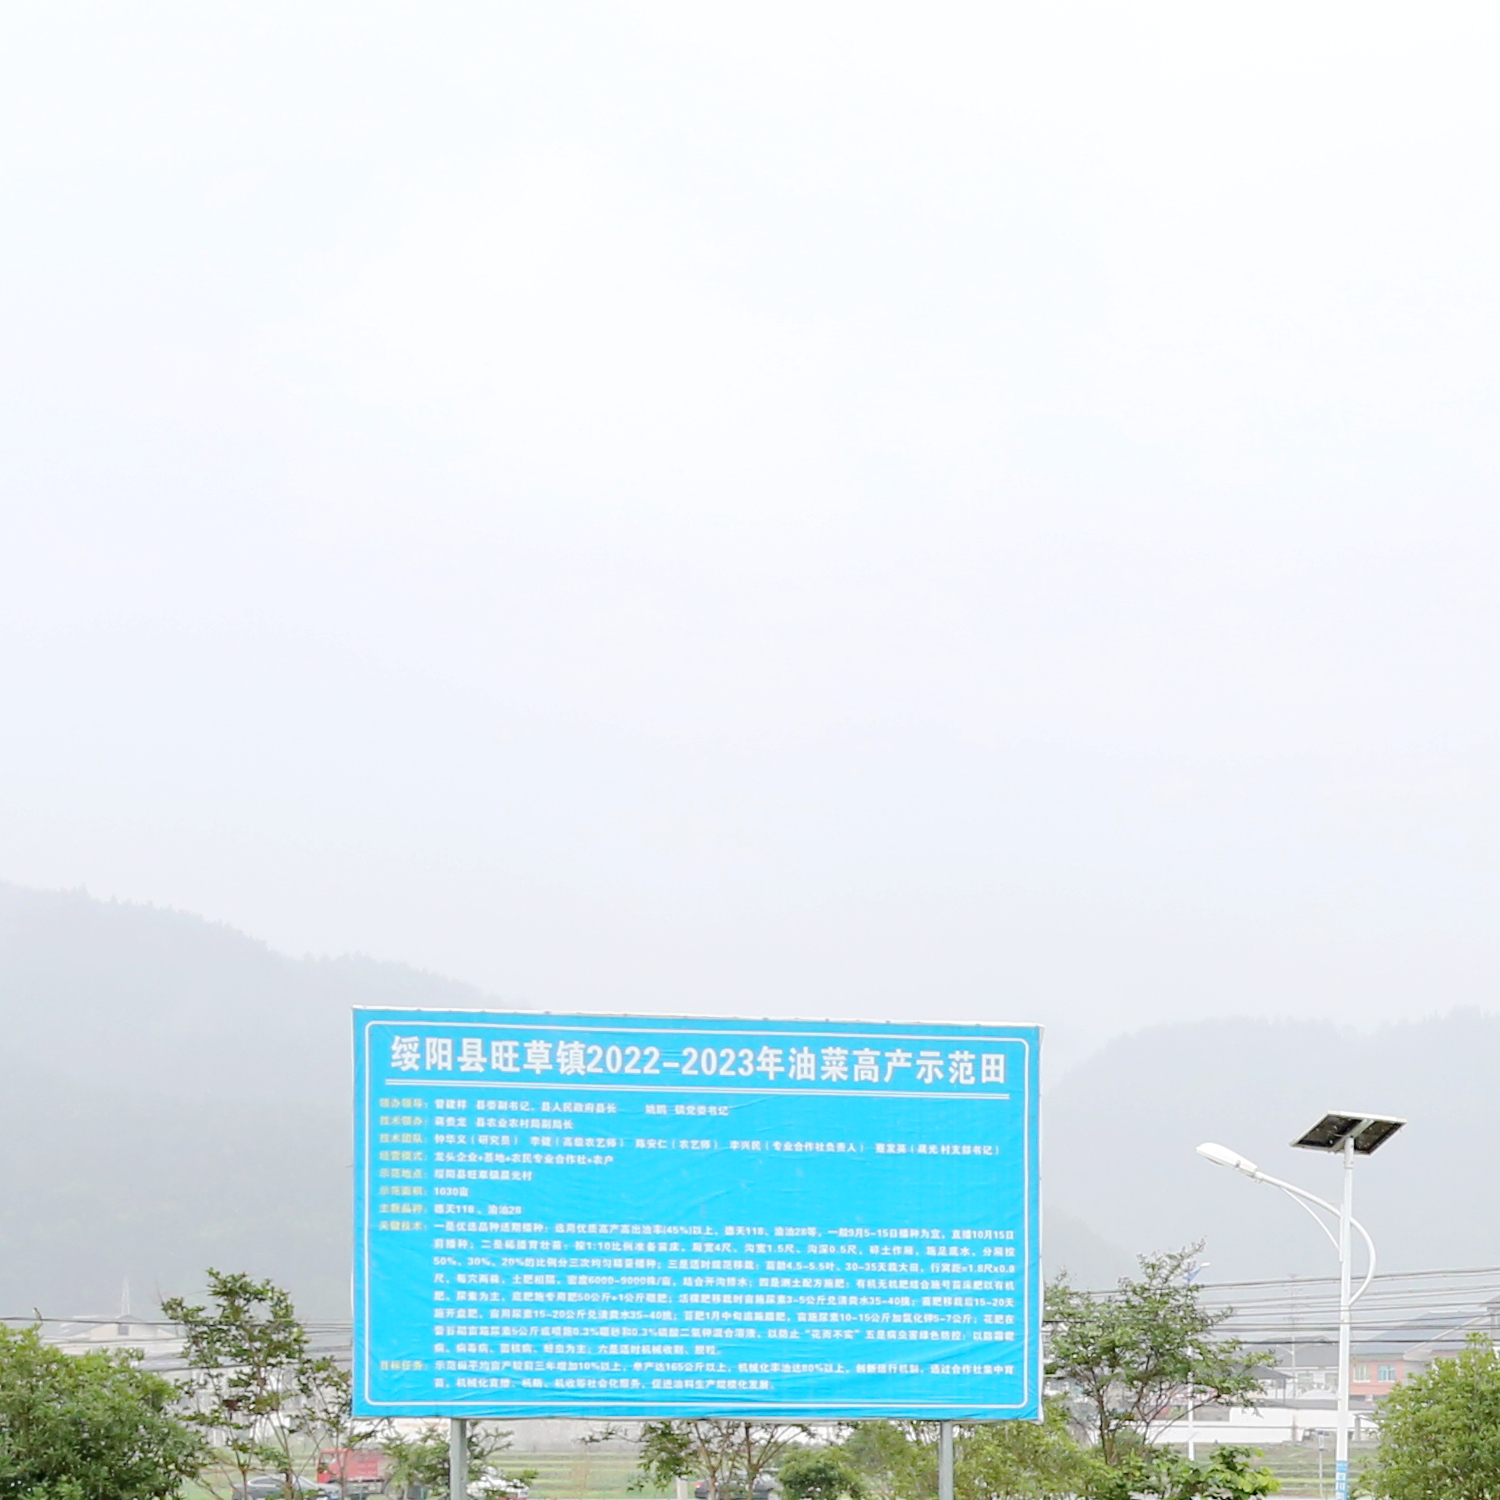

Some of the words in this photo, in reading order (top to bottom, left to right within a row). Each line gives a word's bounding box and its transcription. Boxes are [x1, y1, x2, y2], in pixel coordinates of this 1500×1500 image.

[390, 1035, 1006, 1085] 绥阳县旺草镇2022-2023年油菜高产示范田
[474, 1116, 573, 1129] 县农业农村局副局长
[433, 1186, 469, 1196] 1030亩
